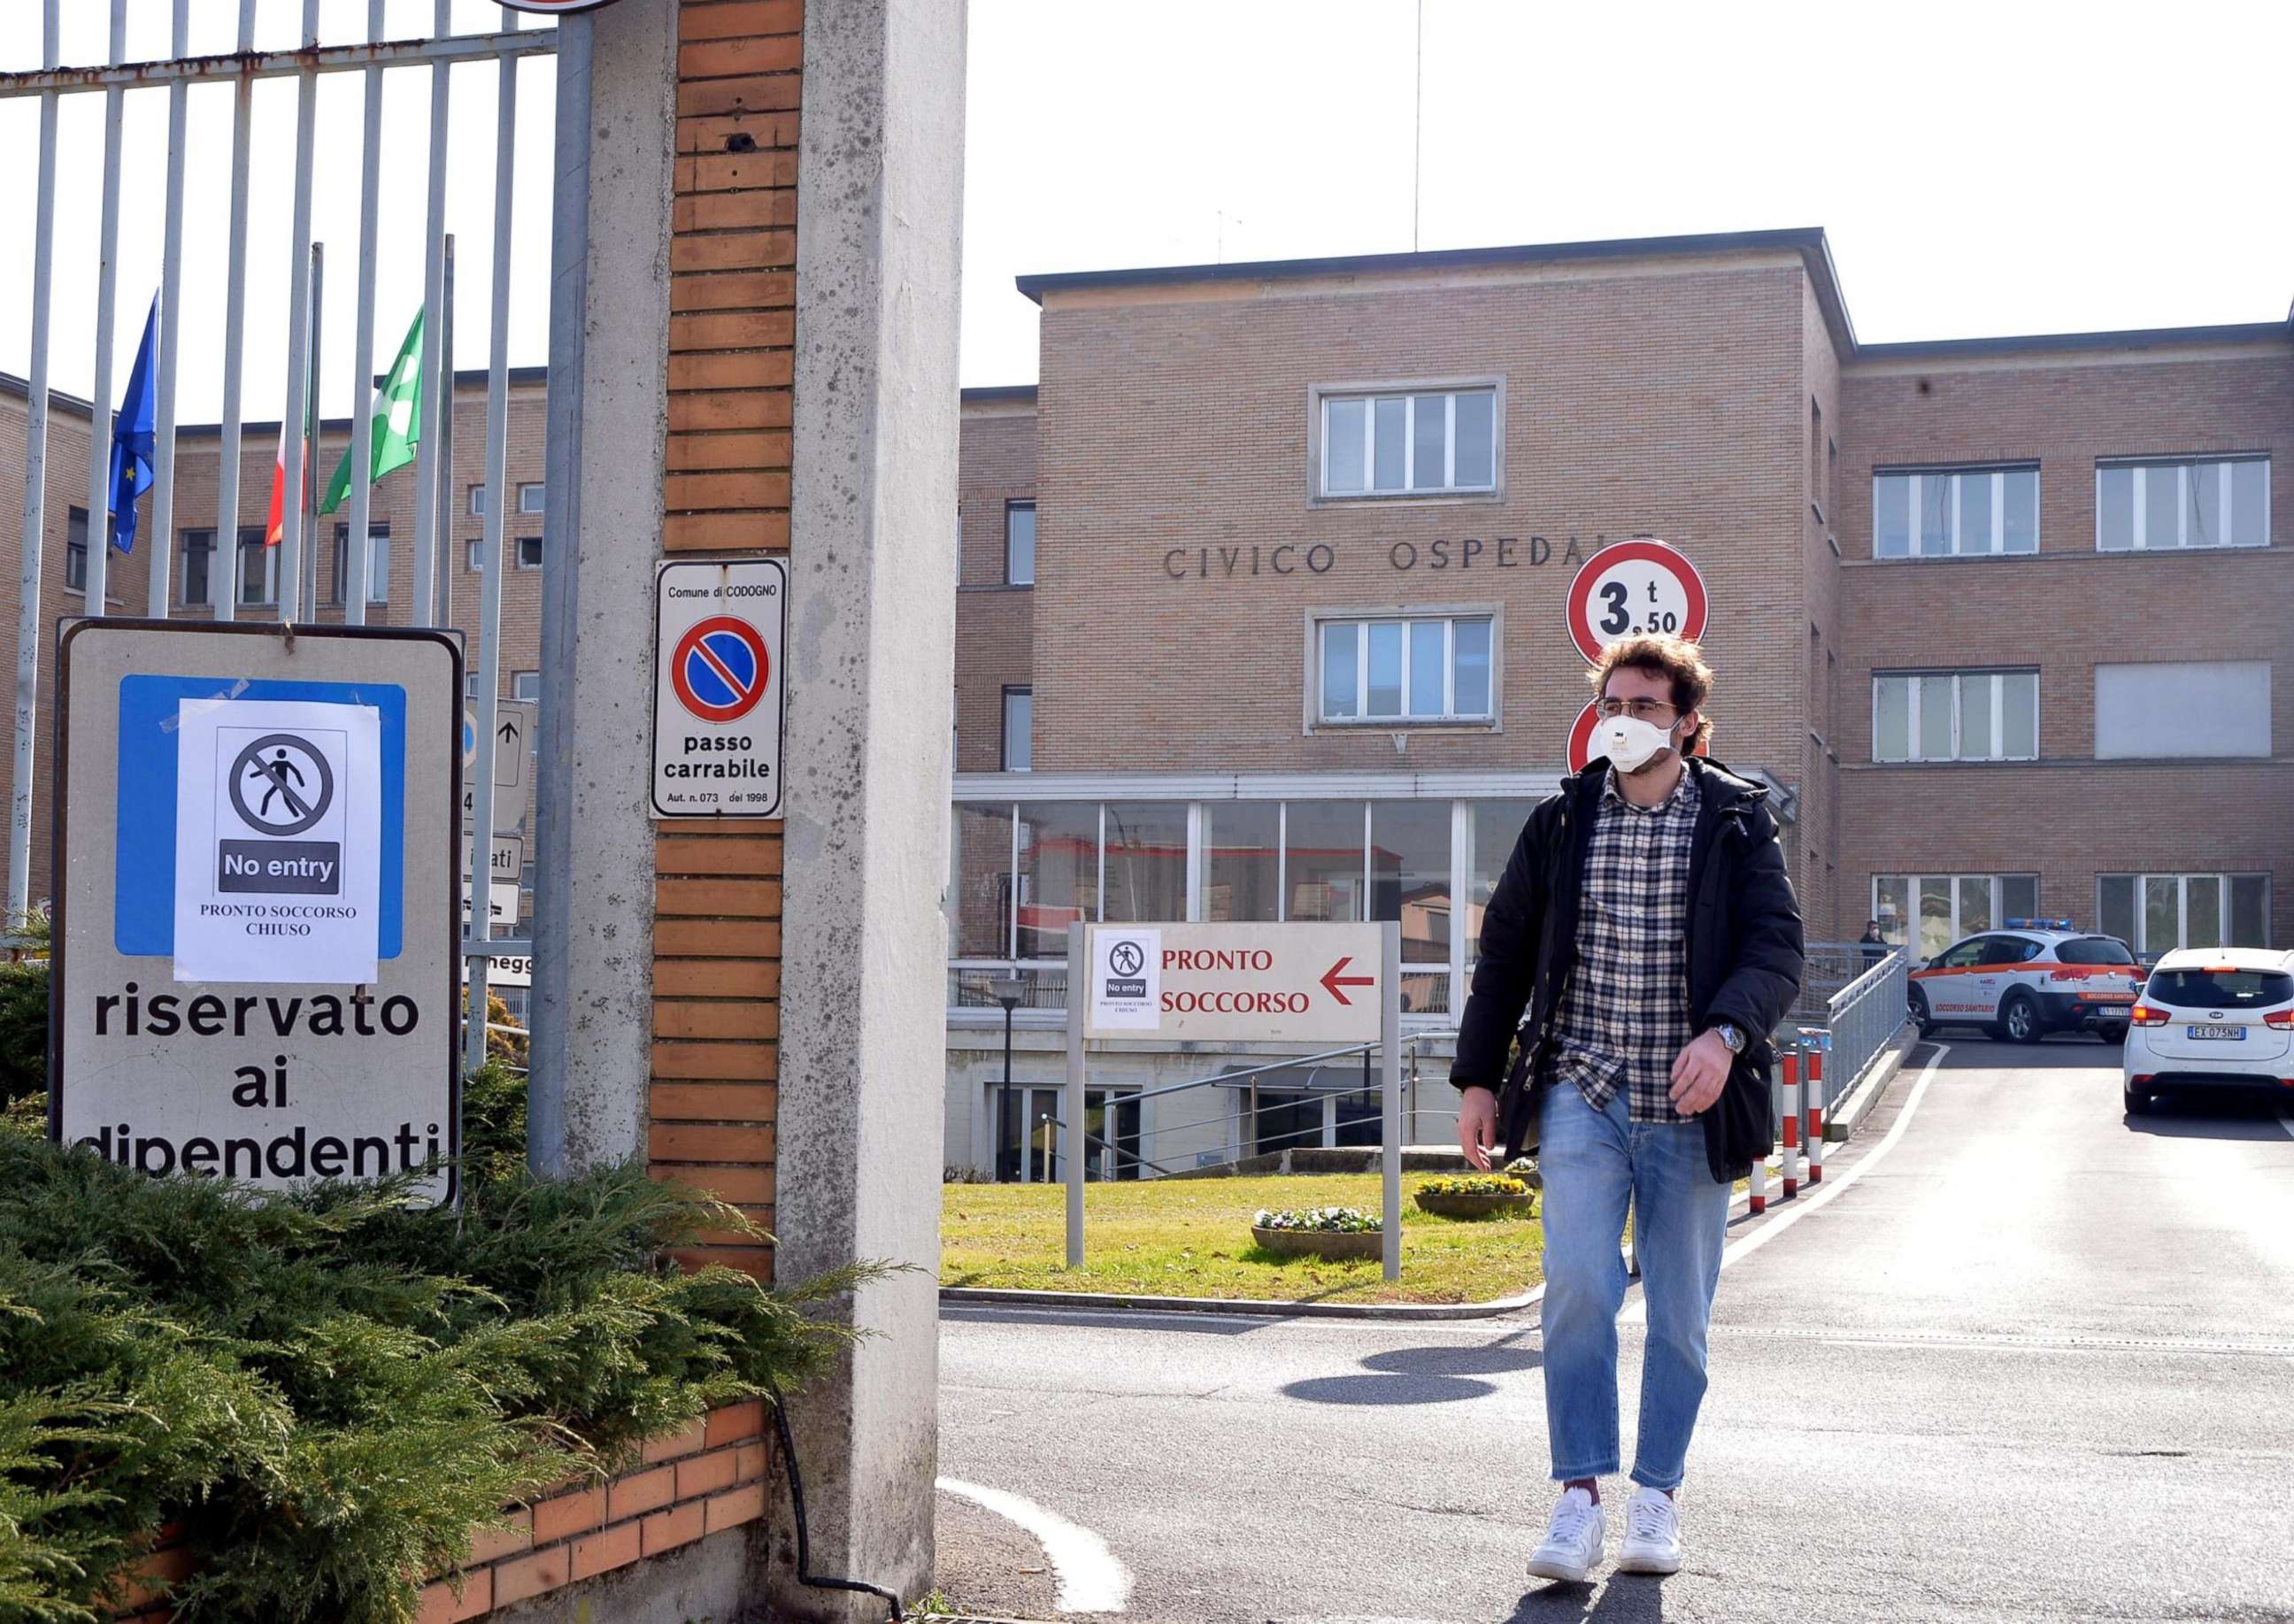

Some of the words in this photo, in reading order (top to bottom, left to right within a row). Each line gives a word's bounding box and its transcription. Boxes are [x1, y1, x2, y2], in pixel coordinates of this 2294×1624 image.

[1164, 543, 1335, 578] CIVICO
[1389, 534, 1652, 571] OSPEDA
[668, 586, 710, 597] Comune
[713, 586, 723, 597] di
[726, 584, 777, 597] CODOGNO
[684, 736, 752, 754] passo
[664, 758, 770, 778] carrabile
[666, 792, 686, 802] Aut.
[699, 792, 719, 802] 073
[729, 792, 743, 802] del
[747, 792, 768, 802] 1998
[225, 854, 260, 876] No
[267, 857, 334, 882] entry
[200, 904, 266, 917] PRONTO
[270, 904, 357, 919] SOCCORSO
[246, 922, 311, 936] CHIUSO
[1161, 950, 1274, 971] PRONTO
[1121, 983, 1144, 994] entry
[95, 981, 420, 1036] riservato
[1160, 991, 1310, 1012] SOCCORSO
[1936, 1004, 1964, 1012] SOCCORSO
[2195, 1027, 2206, 1036] EX
[232, 1055, 288, 1108] ai
